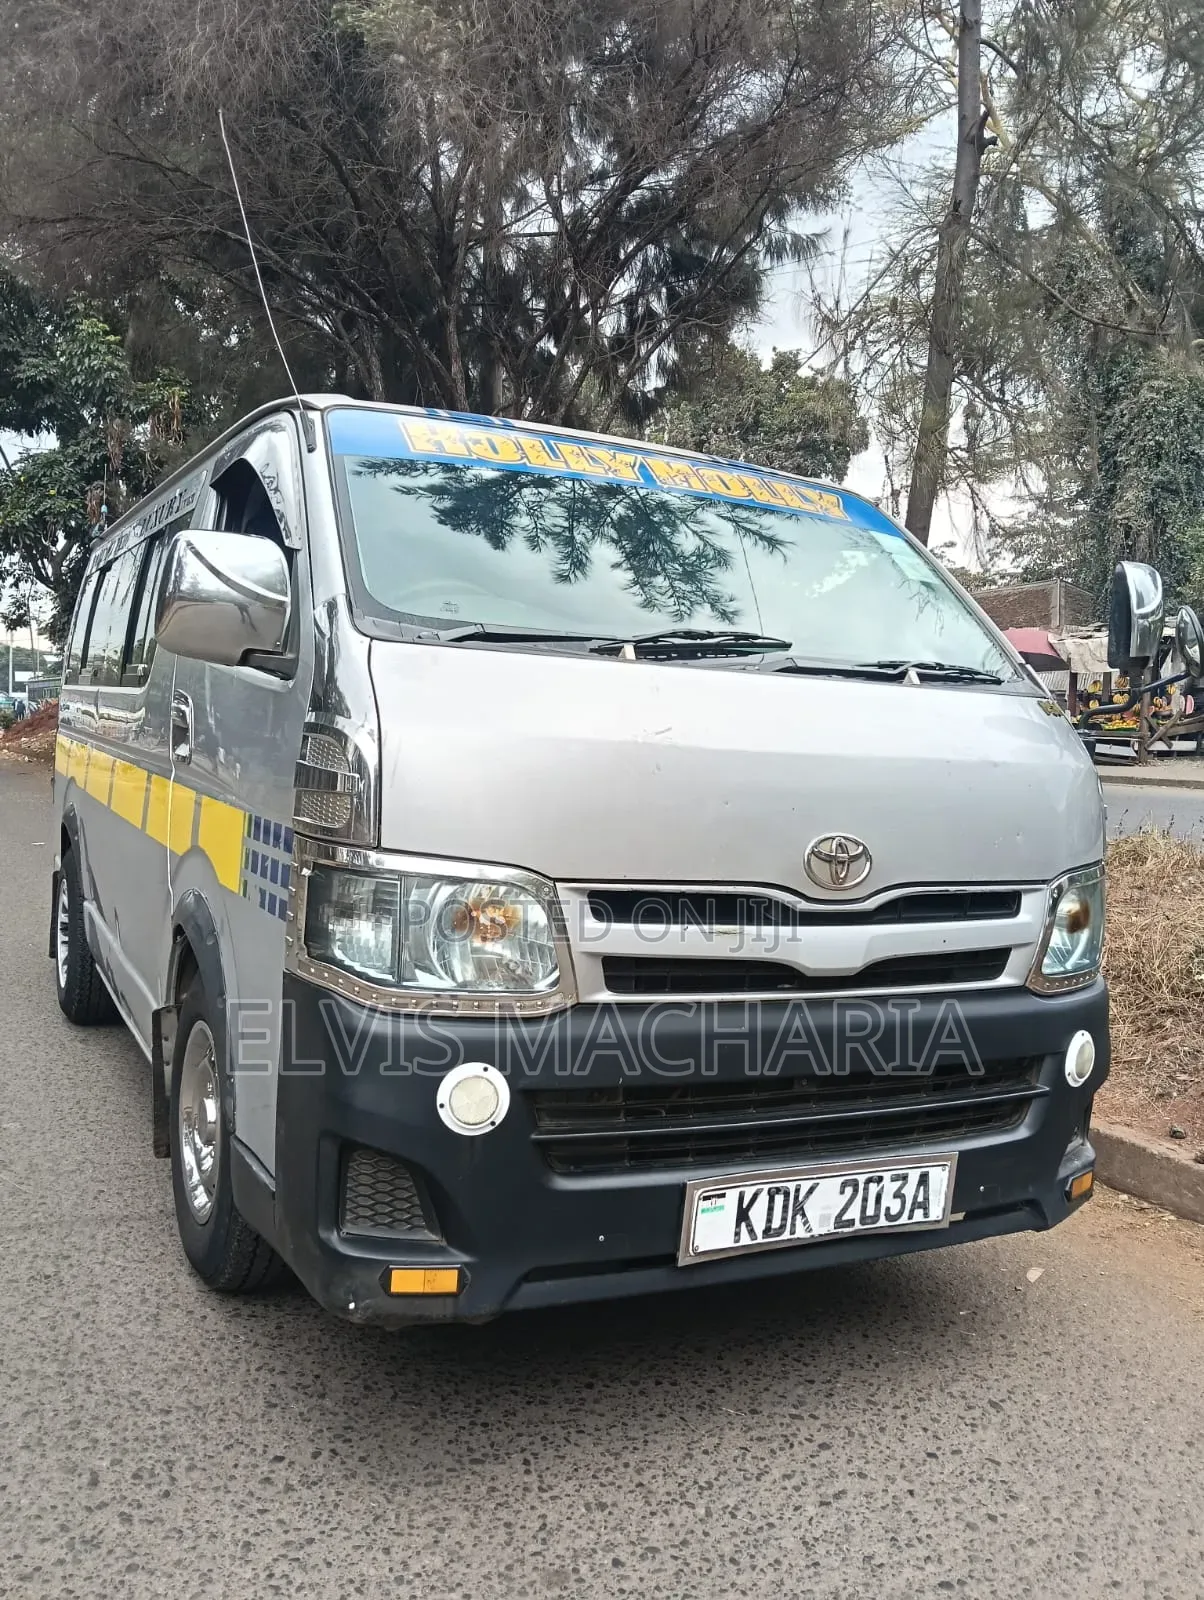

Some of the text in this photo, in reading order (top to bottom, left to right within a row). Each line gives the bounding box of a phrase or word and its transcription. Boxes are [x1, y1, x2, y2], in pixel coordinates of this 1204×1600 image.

[402, 422, 850, 520] HOLLY MOLLY
[733, 1182, 820, 1243] KDK
[833, 1171, 930, 1230] 203A
